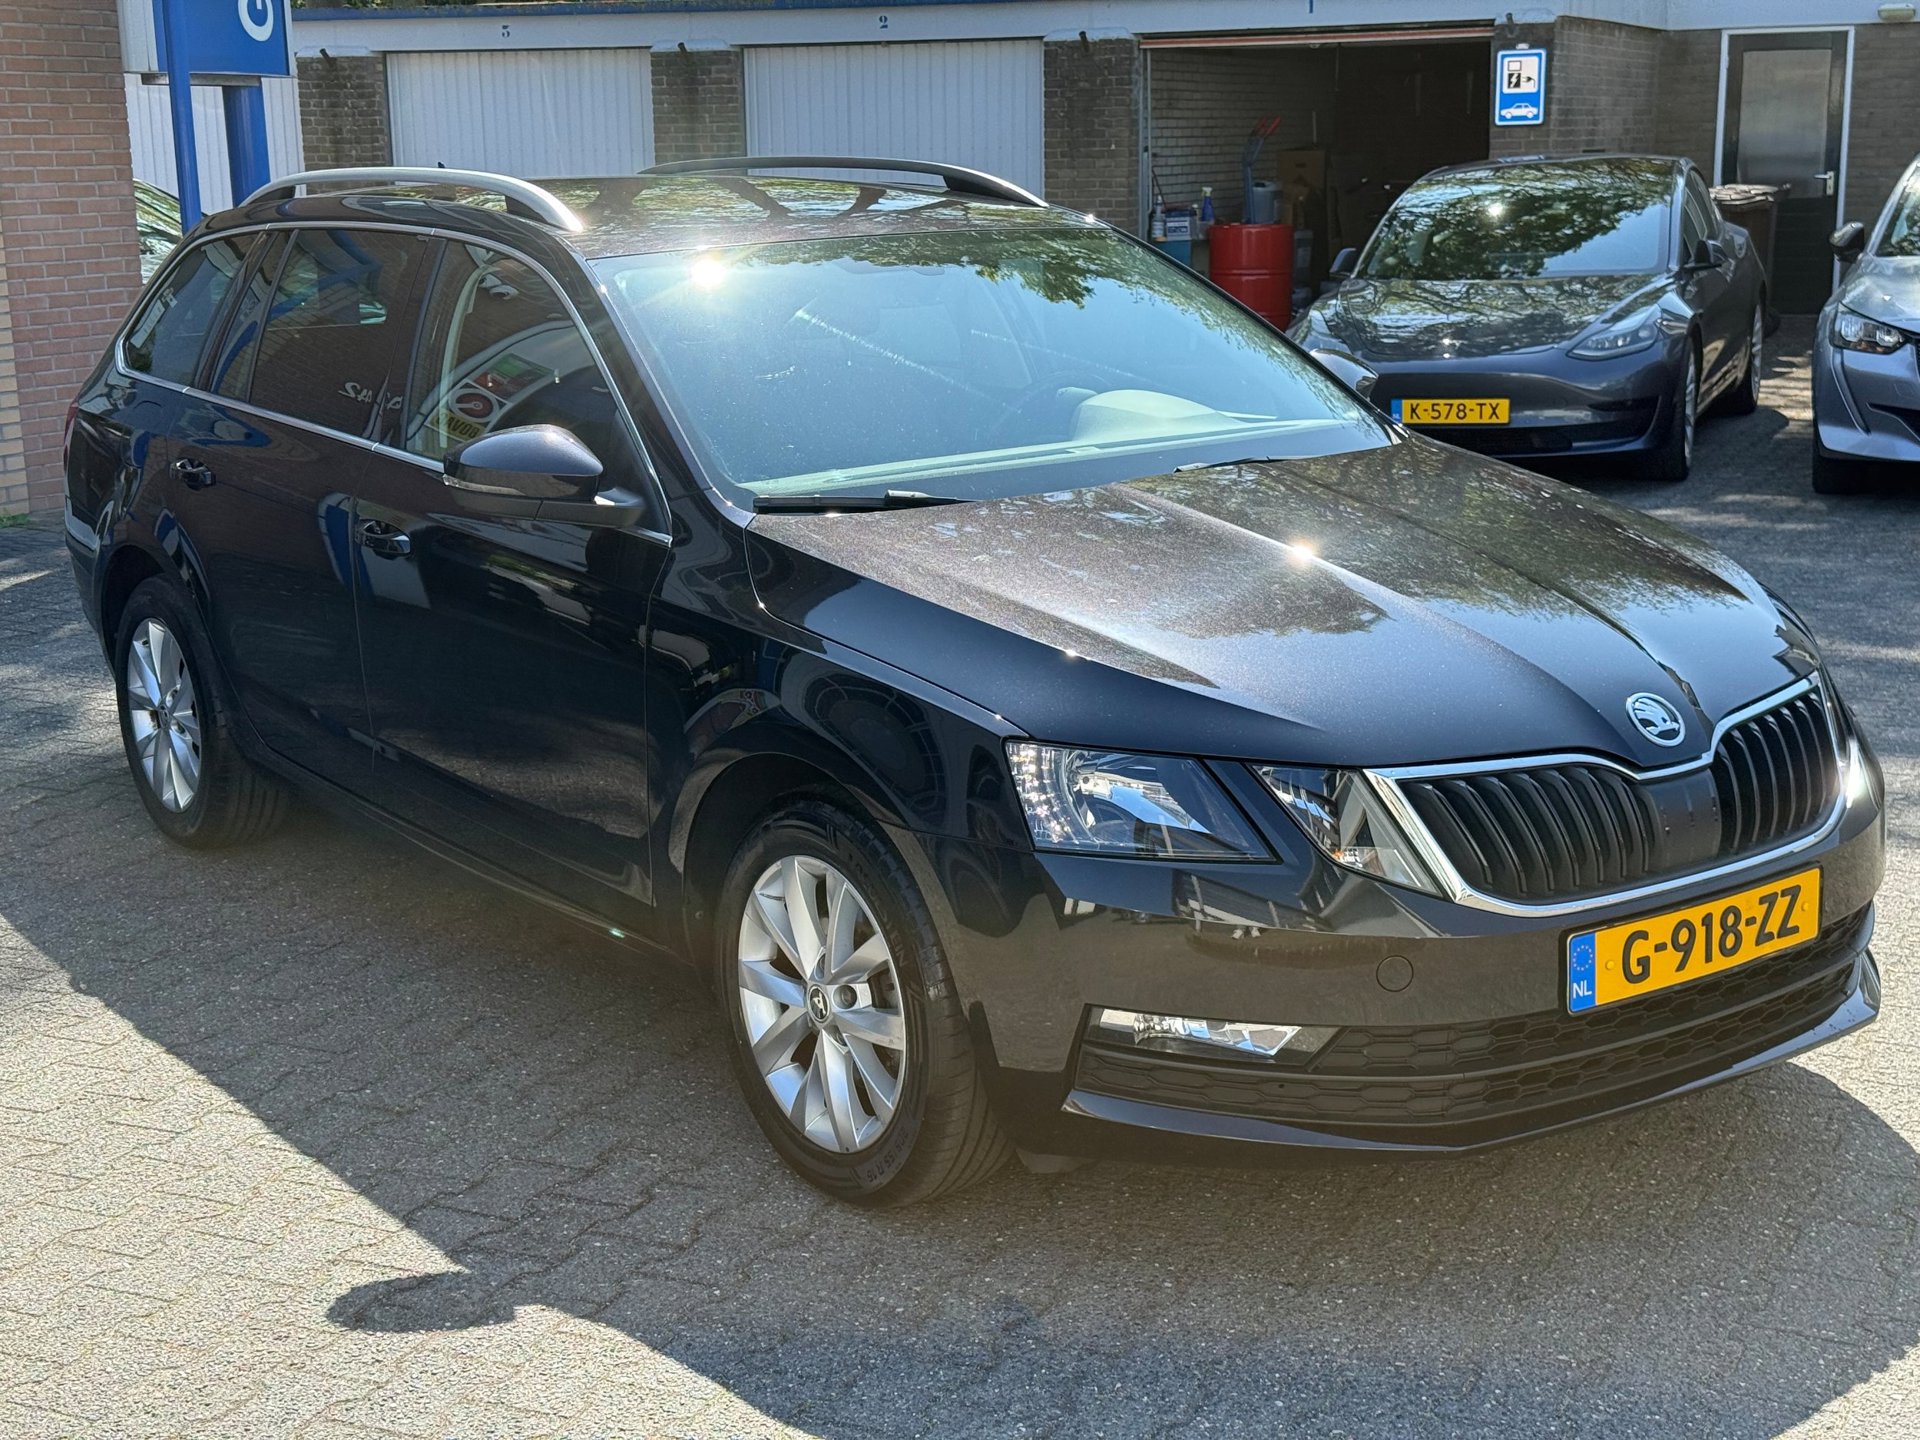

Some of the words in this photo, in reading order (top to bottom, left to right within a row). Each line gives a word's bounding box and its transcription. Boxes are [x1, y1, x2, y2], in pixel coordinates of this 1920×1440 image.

[879, 15, 889, 29] 2
[1409, 402, 1500, 420] K-578-TX
[1621, 884, 1802, 985] G-918-ZZ
[1572, 980, 1593, 999] NL
